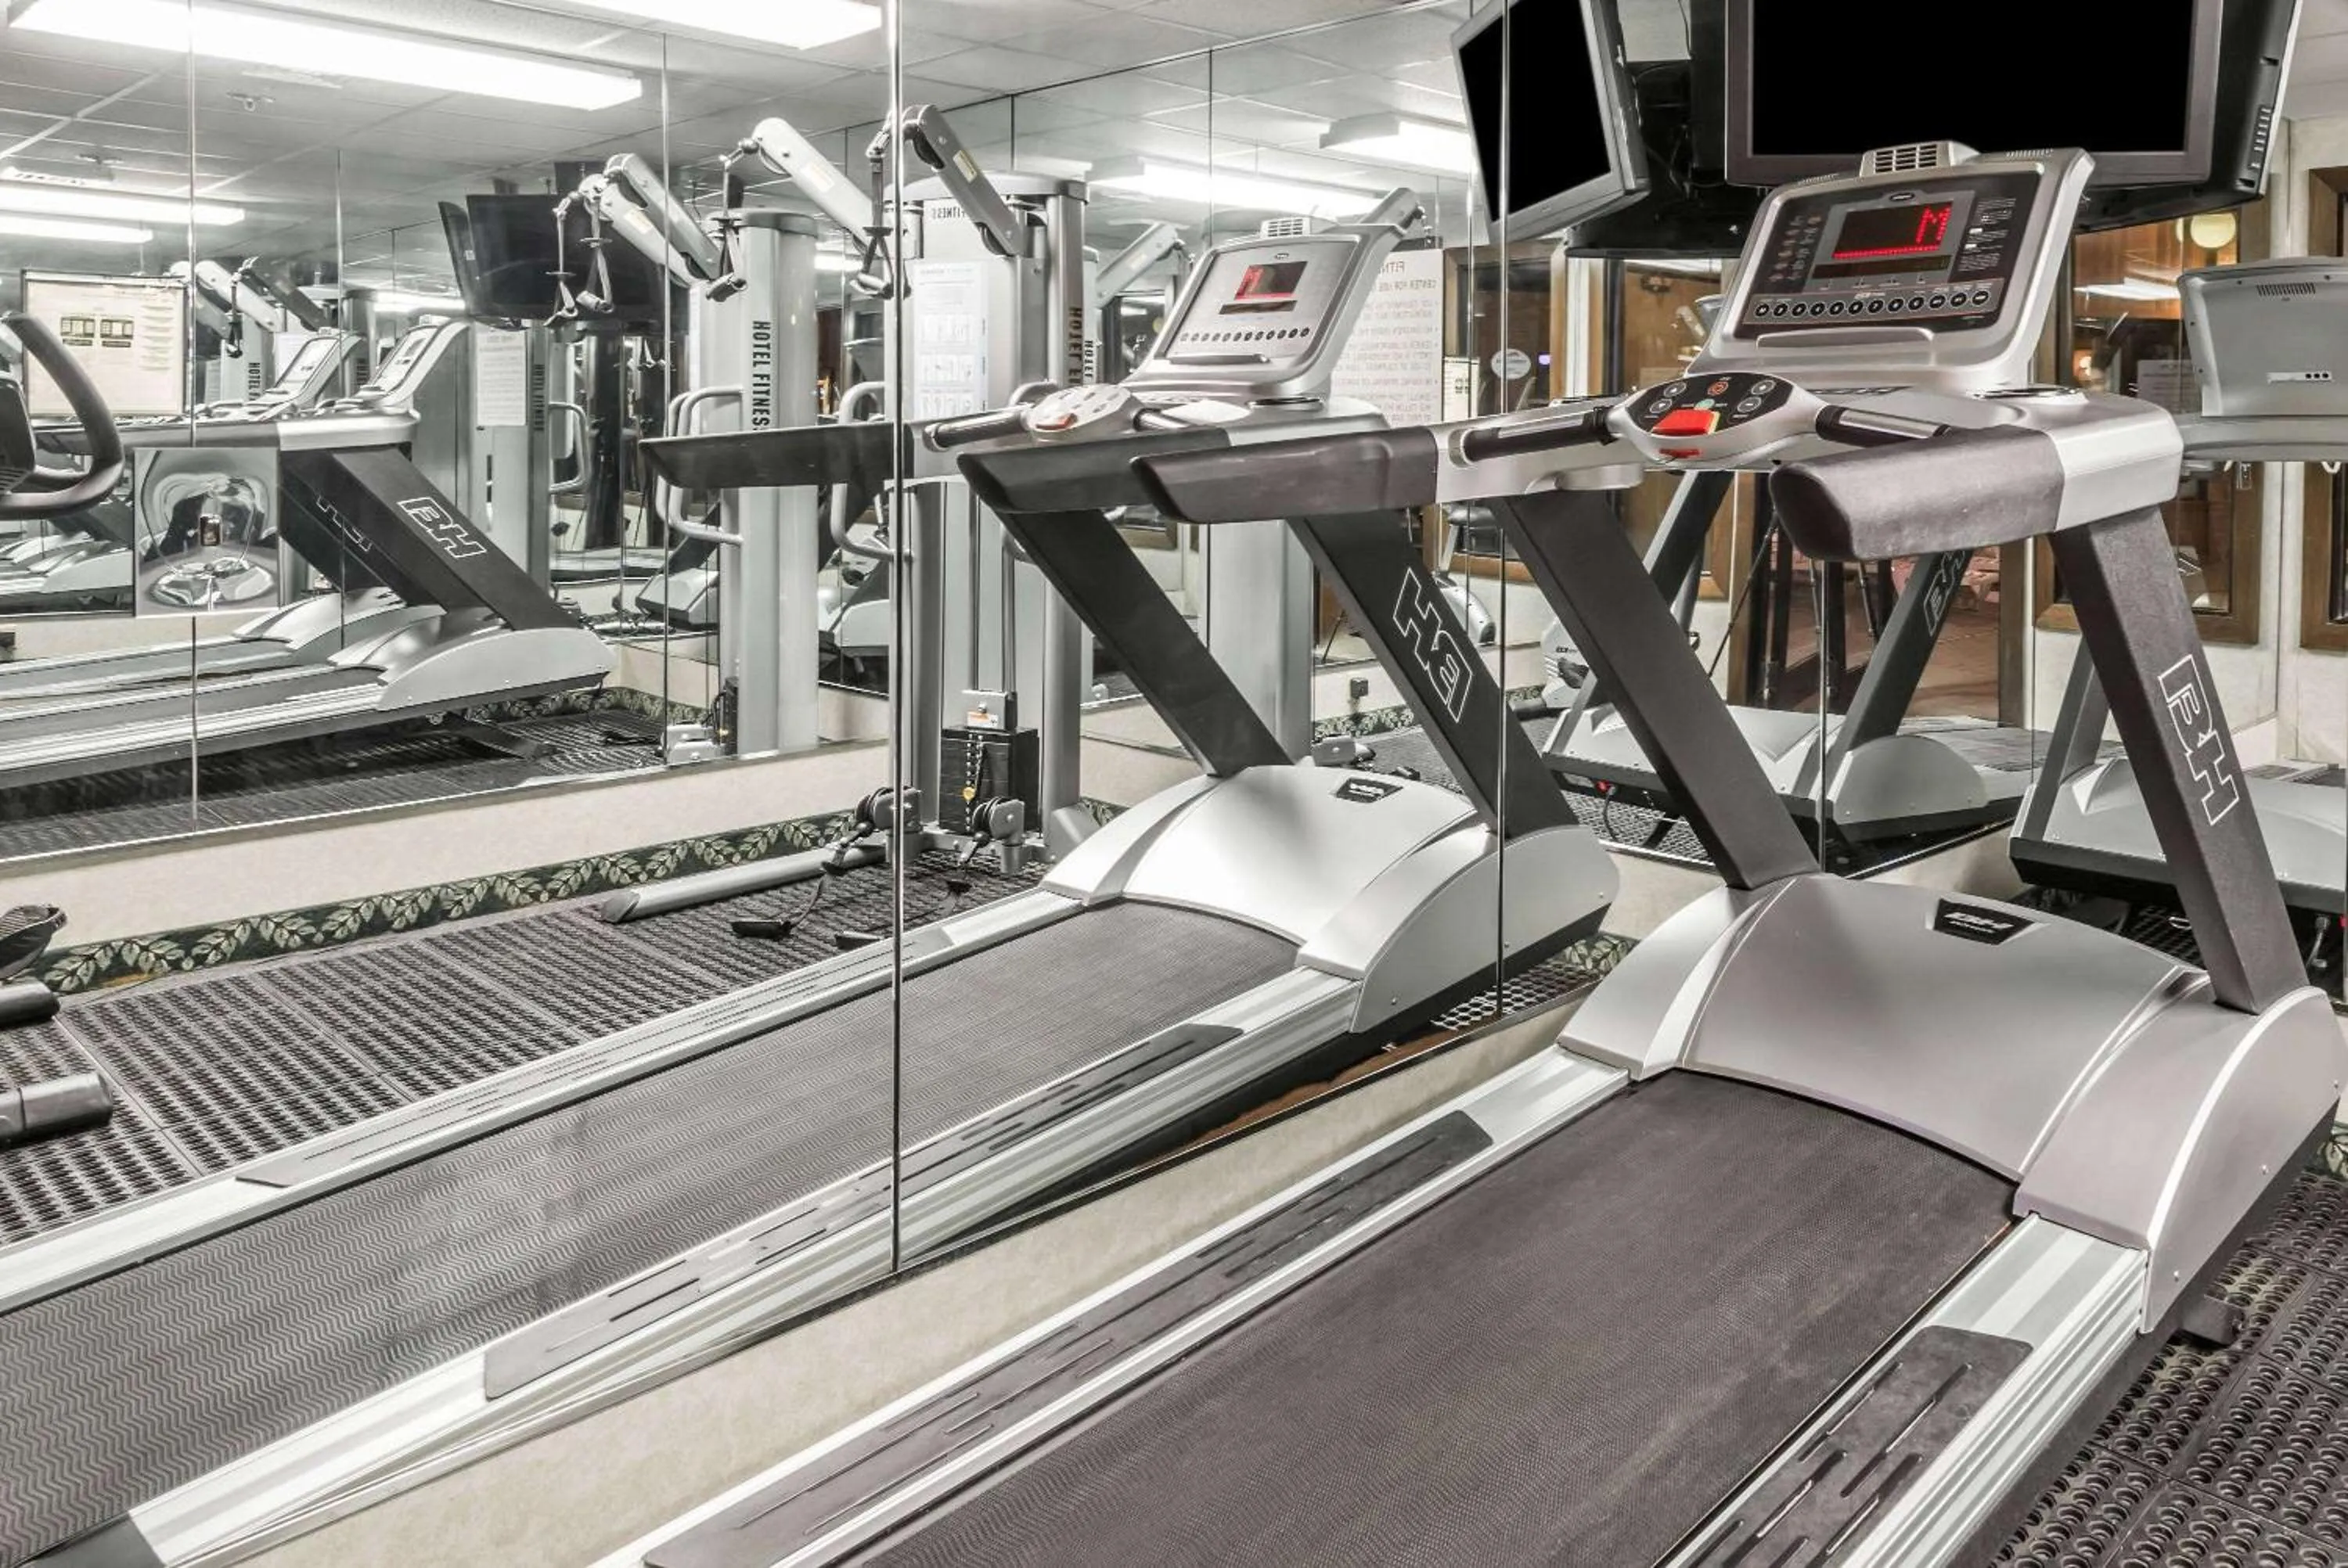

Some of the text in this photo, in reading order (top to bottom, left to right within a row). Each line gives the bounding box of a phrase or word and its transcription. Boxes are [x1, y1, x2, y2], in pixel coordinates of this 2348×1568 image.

[248, 362, 261, 390] HOTEL
[751, 320, 771, 430] HOTEL FITNES
[397, 497, 487, 559] BH
[2158, 654, 2239, 825] BH
